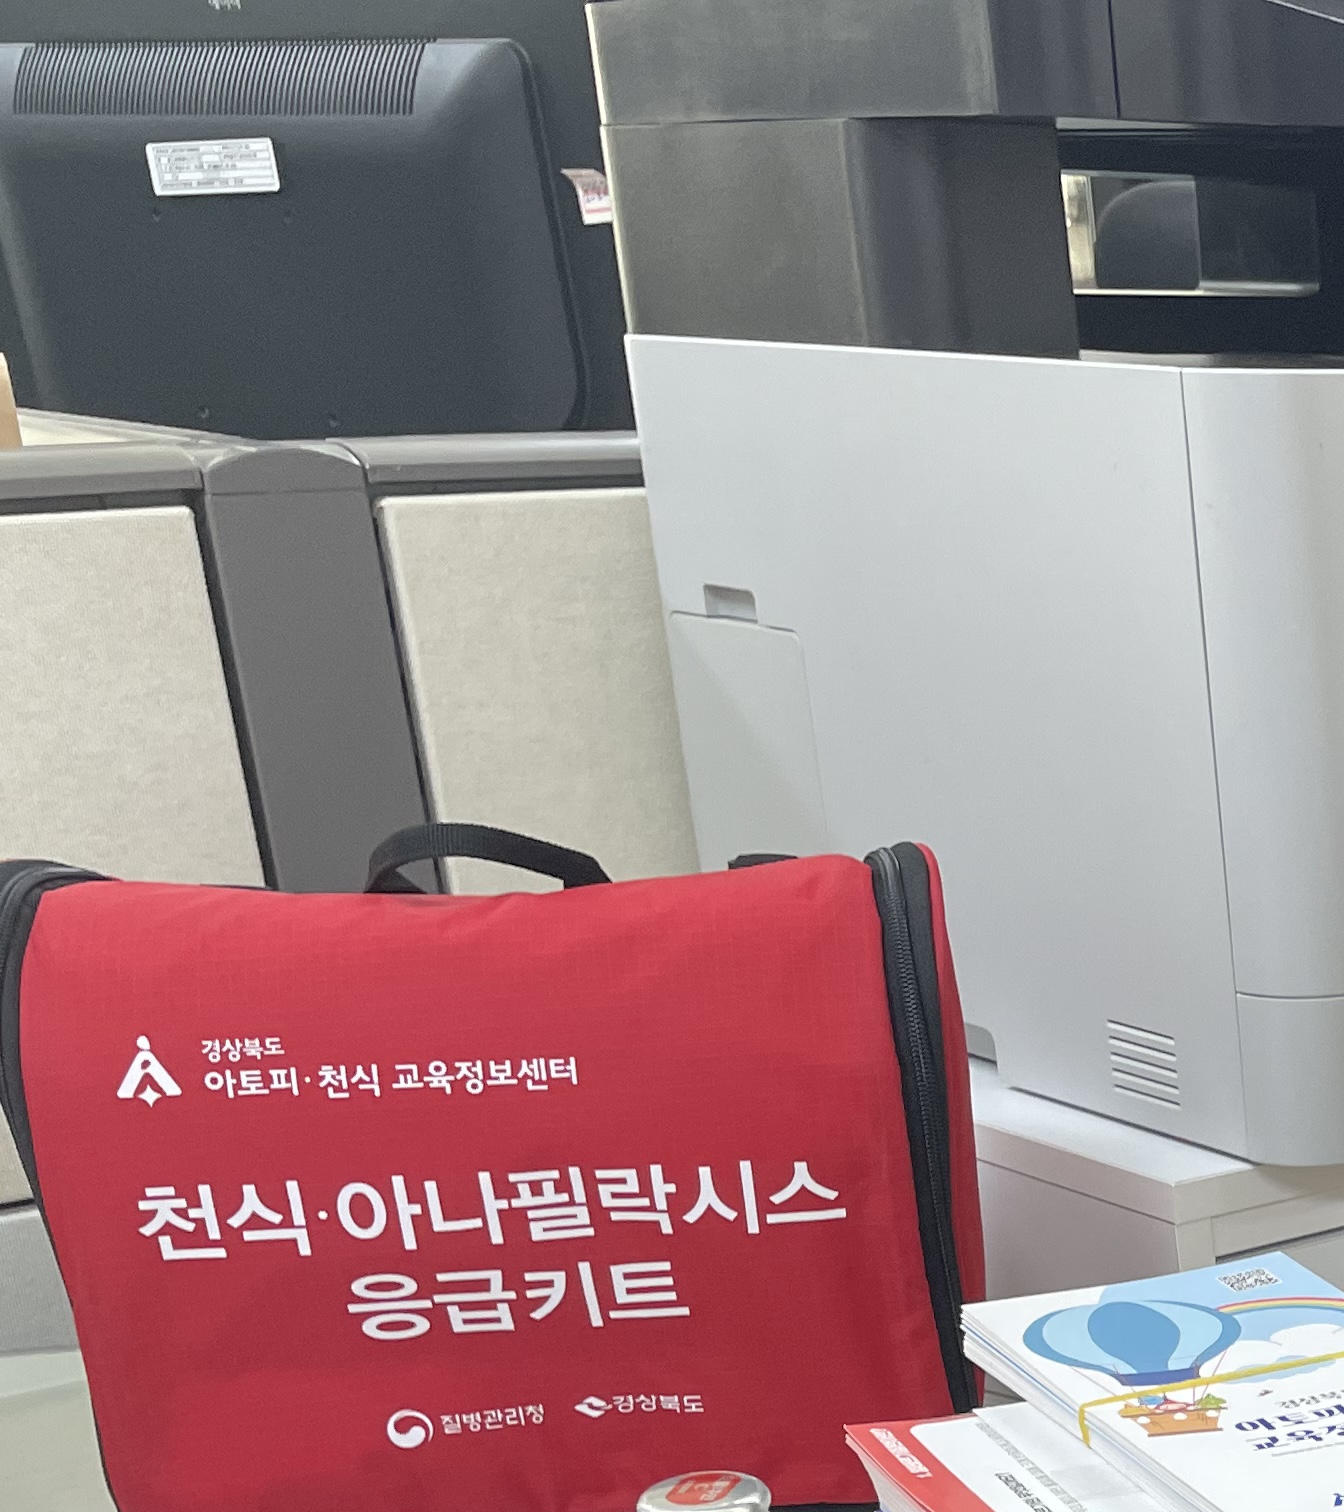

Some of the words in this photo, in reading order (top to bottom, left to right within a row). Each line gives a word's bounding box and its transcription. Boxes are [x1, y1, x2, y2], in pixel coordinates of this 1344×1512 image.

[201, 1036, 285, 1064] 경상북도
[204, 1062, 382, 1099] 아토피·천식
[391, 1056, 579, 1096] 교육정보센터
[137, 1159, 848, 1262] 천식·아나필락시스
[346, 1260, 691, 1341] 응급키트
[440, 1402, 547, 1435] 질병관리청
[612, 1394, 706, 1415] 경상북도
